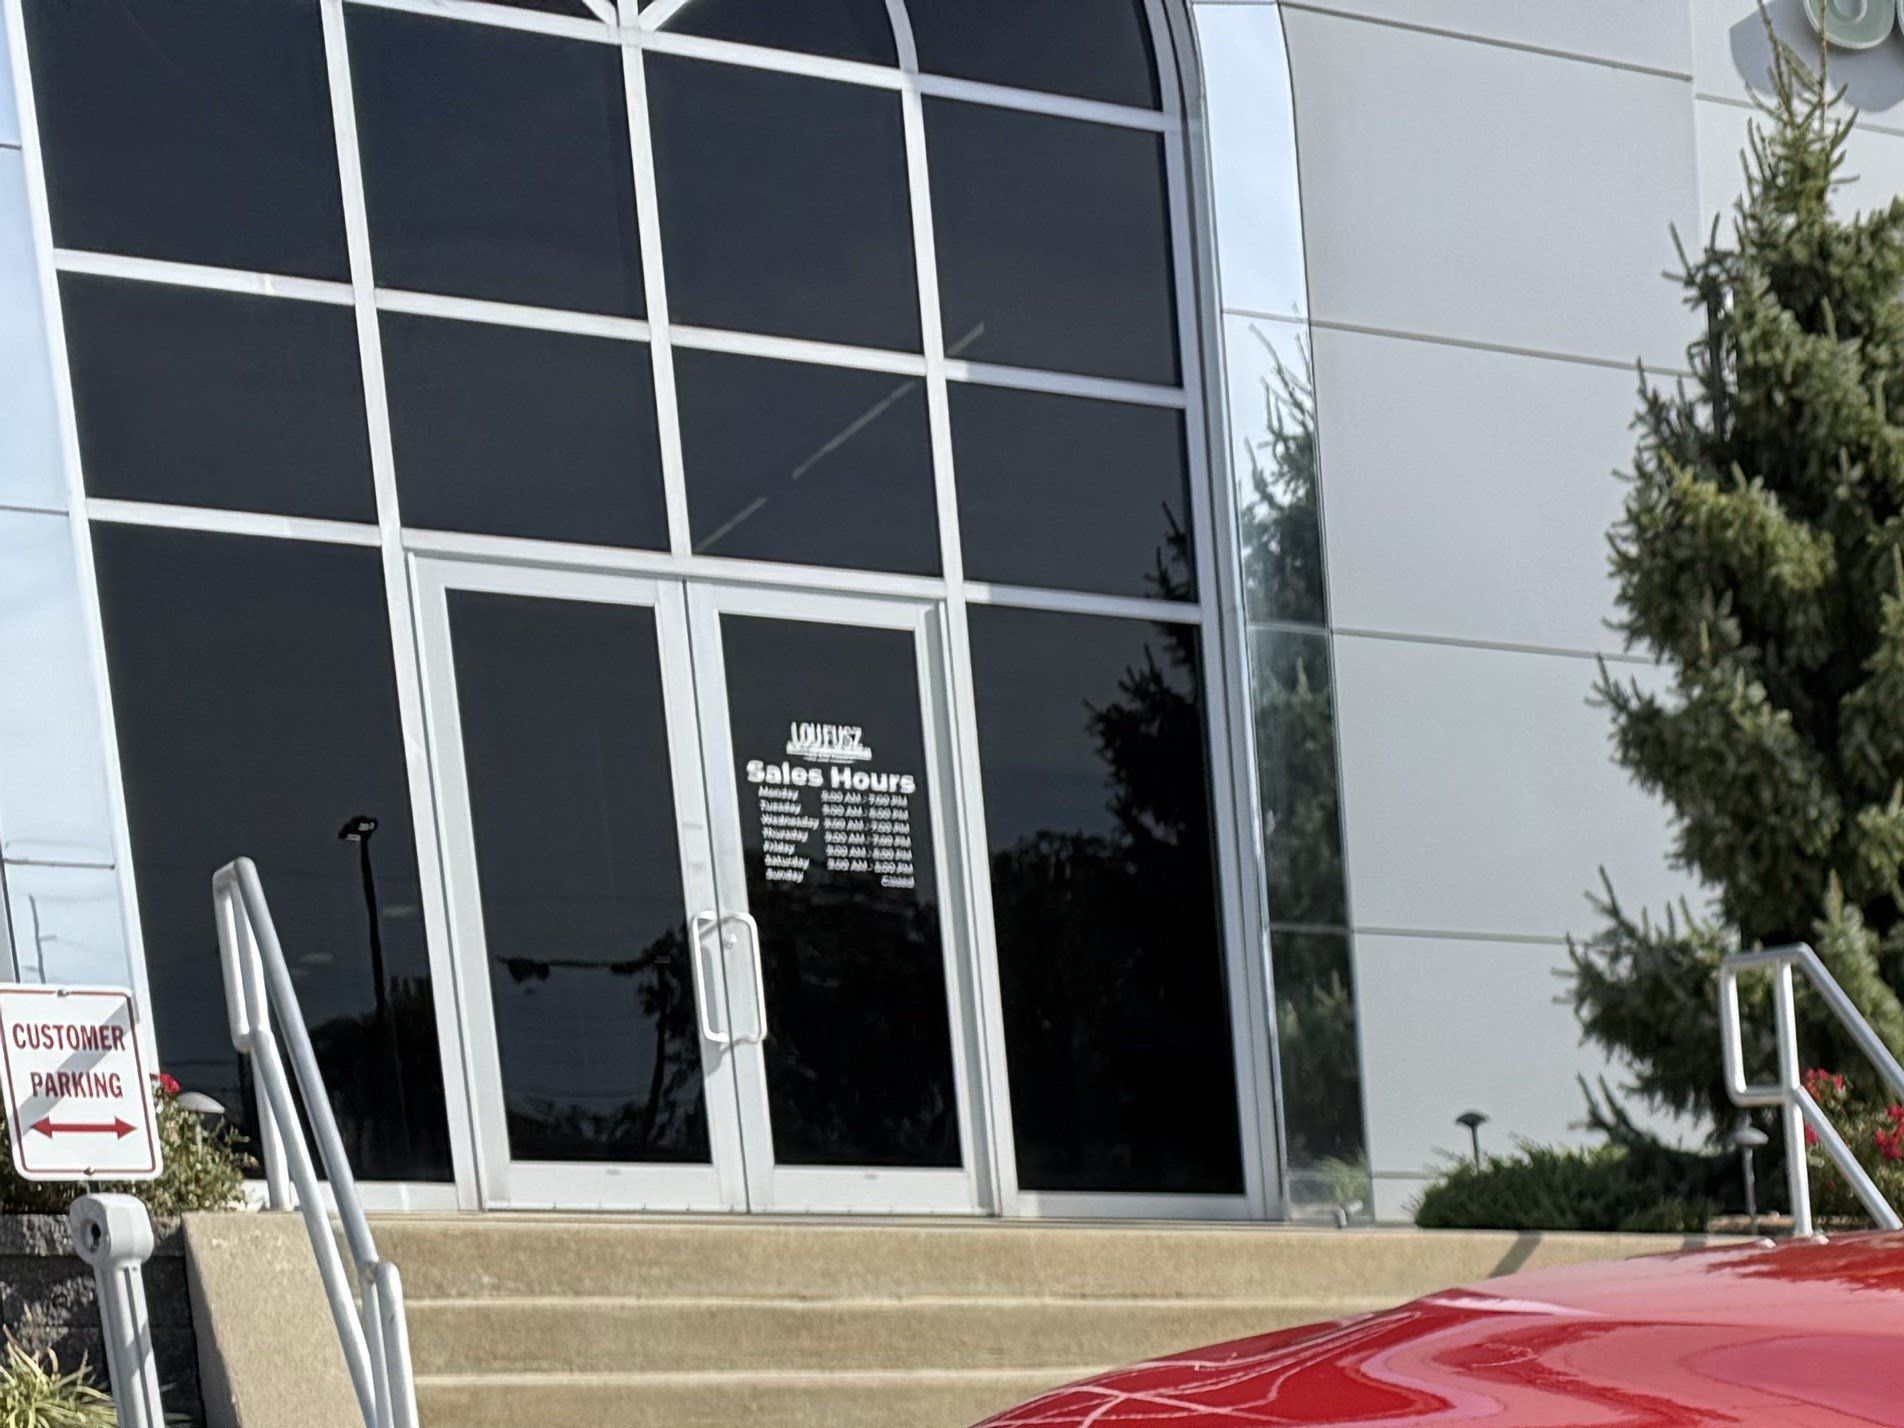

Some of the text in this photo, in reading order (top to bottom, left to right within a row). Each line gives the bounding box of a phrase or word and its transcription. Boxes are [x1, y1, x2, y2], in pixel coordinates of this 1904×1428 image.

[746, 759, 916, 794] Sales Hours
[758, 786, 799, 801] Monday
[759, 799, 801, 815] Tuesday
[761, 813, 819, 830] Wednesday
[12, 1023, 126, 1051] CUSTOMER
[30, 1071, 123, 1098] PARKING
